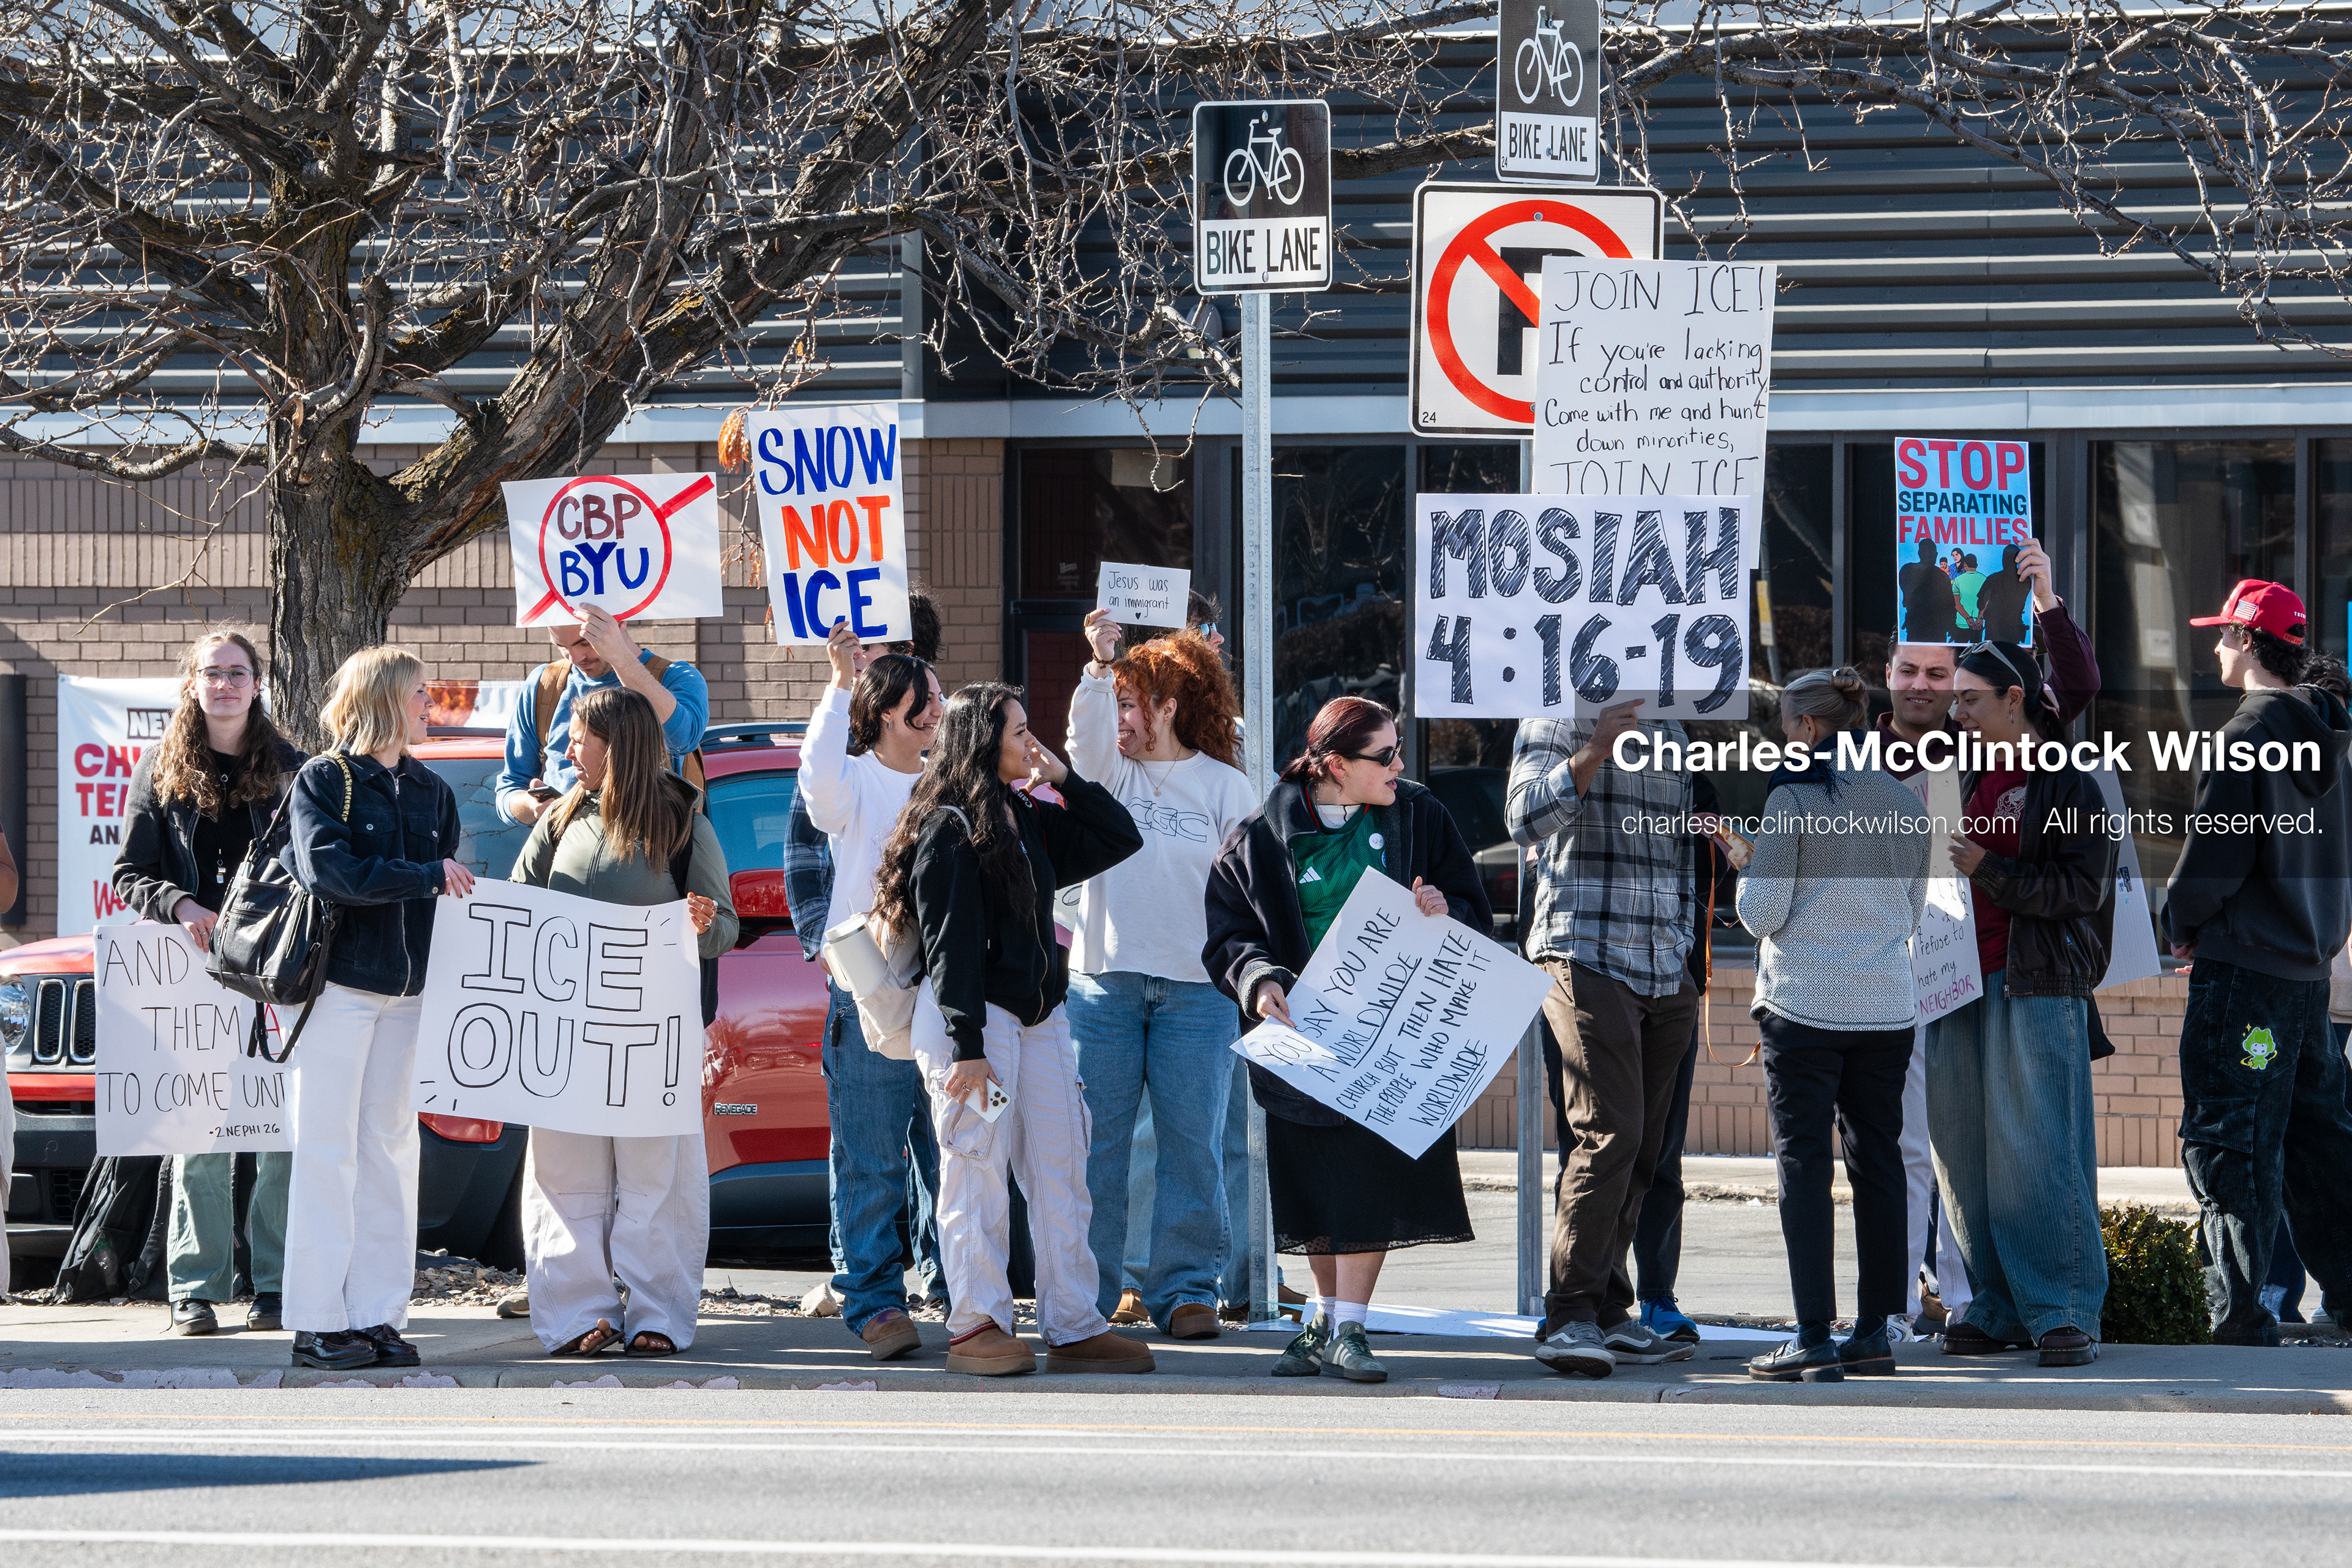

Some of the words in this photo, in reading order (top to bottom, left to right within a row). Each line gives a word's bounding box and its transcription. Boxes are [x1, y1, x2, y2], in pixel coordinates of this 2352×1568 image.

[1501, 156, 1508, 168] 24
[1509, 123, 1542, 160] BIKE
[1550, 126, 1588, 162] LANE
[1207, 230, 1256, 275] BIKE
[1267, 227, 1321, 273] LANE
[1555, 270, 1660, 310] JOIN
[1684, 265, 1764, 315] ICE!
[1549, 320, 1583, 365] If
[1600, 342, 1665, 377] you're
[1685, 326, 1763, 373] lacking
[1580, 364, 1648, 393] control
[1660, 372, 1682, 390] and
[1689, 364, 1769, 407] authority,
[1422, 411, 1436, 423] 24
[1545, 398, 1589, 427] Come
[1597, 399, 1638, 422] with
[1650, 406, 1672, 420] me
[1681, 402, 1711, 420] and
[1720, 398, 1766, 420] hunt
[758, 424, 897, 496] SNOW
[1577, 429, 1624, 452] down
[1637, 426, 1734, 453] minorities,
[1898, 439, 2026, 491] STOP
[557, 492, 642, 540] CBP
[1899, 491, 2027, 516] SEPARATING
[780, 495, 891, 570] NOT
[1899, 515, 2028, 545] FAMILIES
[560, 541, 649, 597] BYU
[1430, 507, 1741, 606] MOSIAH
[783, 567, 888, 639] ICE
[1108, 571, 1139, 590] Jesus
[1148, 578, 1169, 592] was
[1109, 595, 1119, 607] an
[1125, 595, 1169, 618] immigrant
[461, 903, 649, 1012] ICE
[1913, 942, 1918, 960] I
[1921, 934, 1951, 956] refuse
[1953, 922, 1964, 941] to
[1256, 1035, 1312, 1066] YOU
[1294, 998, 1340, 1038] SAY
[1323, 951, 1366, 995] YOU
[1357, 907, 1401, 954] ARE
[1917, 968, 1939, 990] hate
[1941, 960, 1958, 985] my
[1920, 974, 1975, 1019] NEIGHBOR
[141, 1003, 243, 1055] THEM
[1336, 1071, 1381, 1109] CHURCH
[1374, 1043, 1406, 1075] BUT
[1398, 990, 1438, 1039] THEN
[1424, 929, 1472, 989] HATE
[1411, 1032, 1450, 1069] WHO
[1439, 978, 1477, 1027] MAKE
[1467, 949, 1491, 971] IT
[447, 1003, 681, 1107] OUT!
[1306, 1064, 1341, 1083] A
[98, 1072, 140, 1115] TO
[154, 1072, 229, 1112] COME
[1409, 1039, 1488, 1127] WORLDWIDE
[226, 1125, 261, 1137] NEPHI
[263, 1123, 281, 1134] 26
[714, 1103, 757, 1114] RENEGADE
